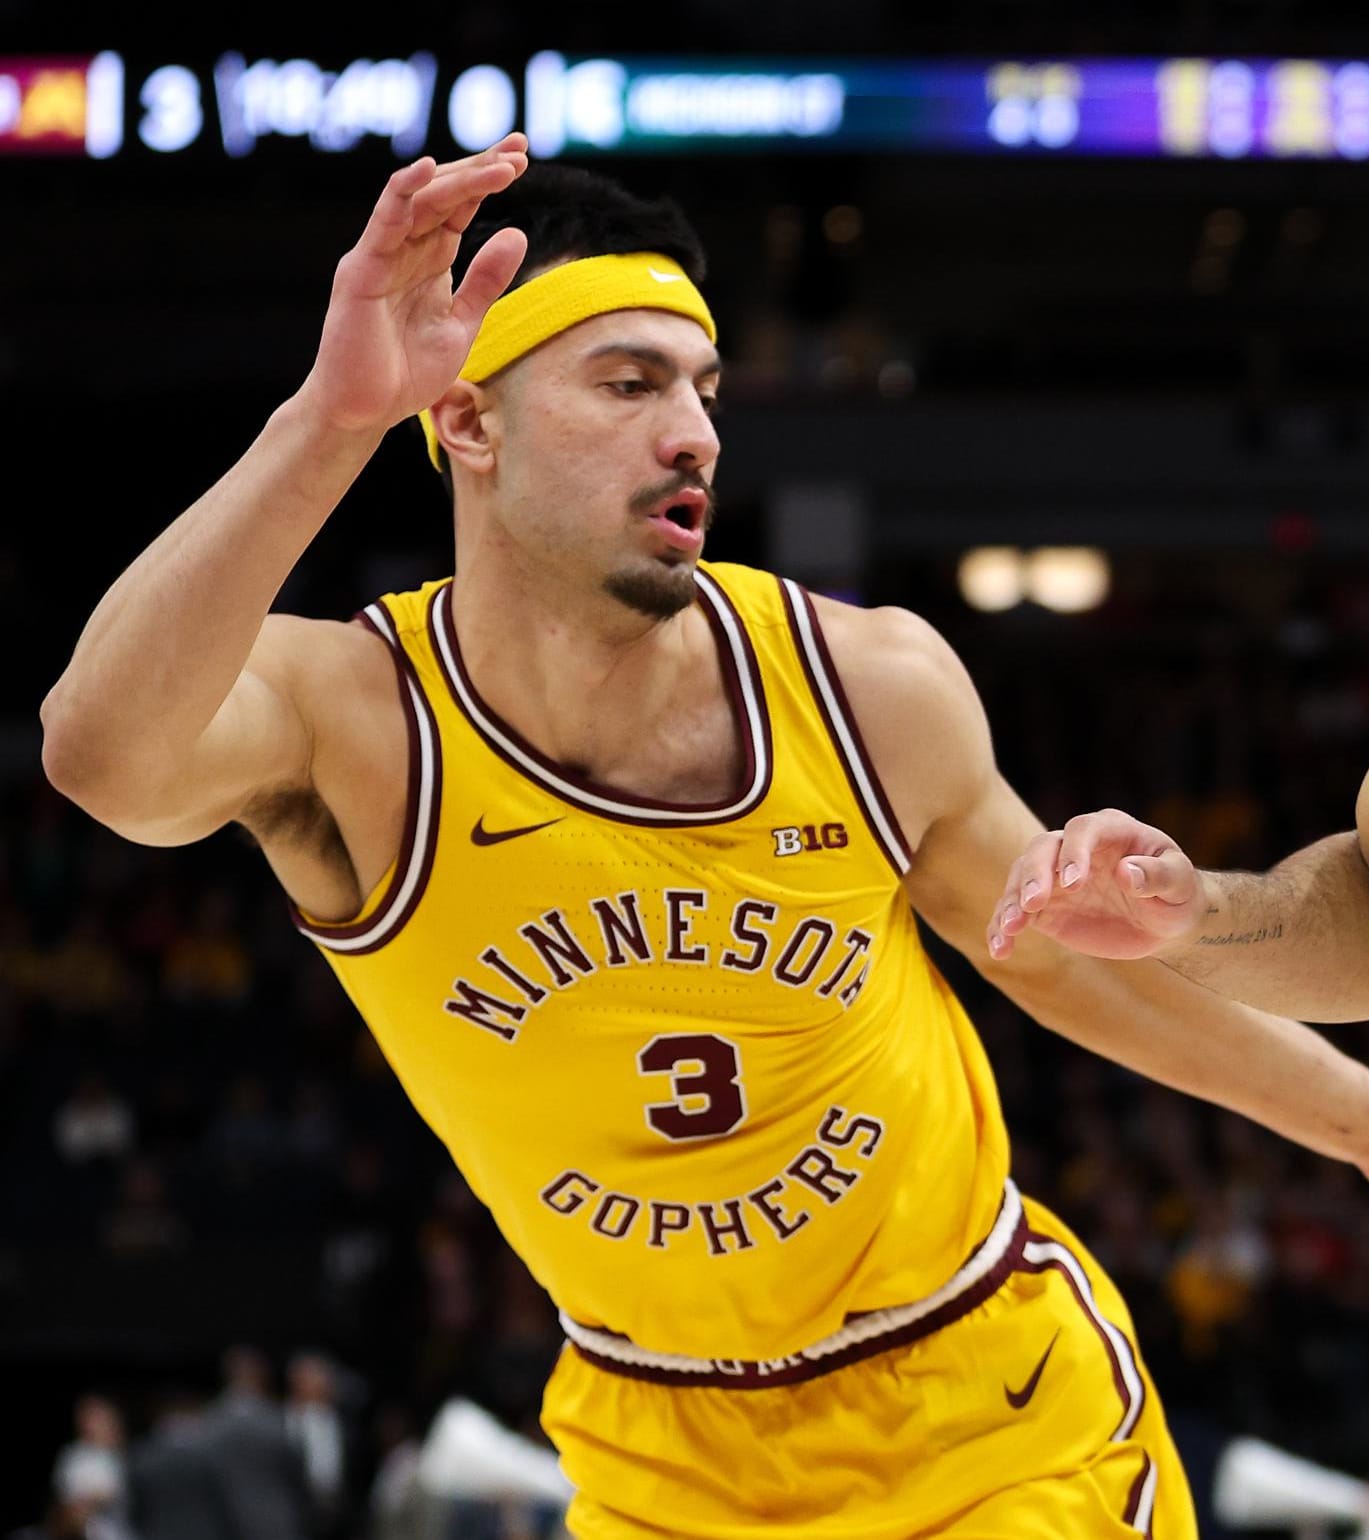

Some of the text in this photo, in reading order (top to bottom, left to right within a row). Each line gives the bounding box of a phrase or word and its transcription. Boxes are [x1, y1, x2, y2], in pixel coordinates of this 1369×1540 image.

[138, 64, 201, 152] 3
[771, 822, 849, 857] B1G
[636, 1032, 747, 1143] 3
[540, 1105, 884, 1257] GOPHERS
